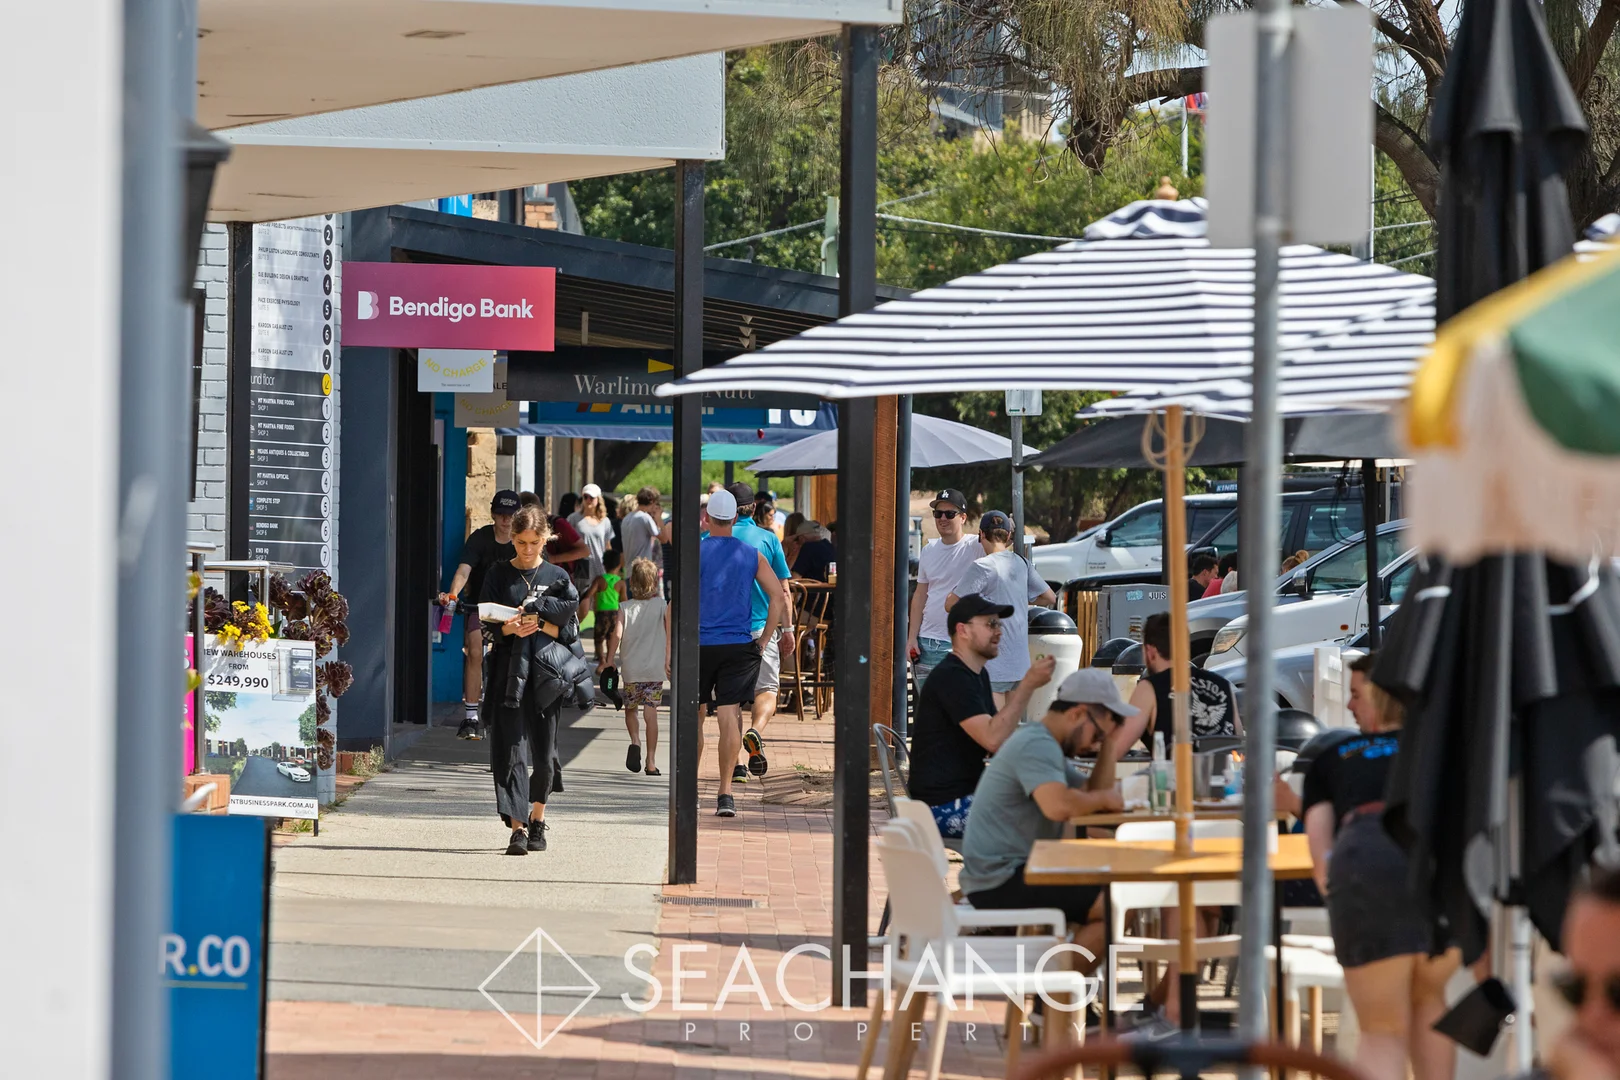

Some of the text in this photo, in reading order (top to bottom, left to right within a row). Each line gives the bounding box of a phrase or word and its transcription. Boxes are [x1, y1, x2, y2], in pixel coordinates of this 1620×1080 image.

[326, 230, 330, 240] 2
[299, 250, 320, 258] CONSULTANTS
[326, 255, 330, 265] 3
[325, 280, 330, 290] 4
[325, 305, 329, 315] 5
[389, 296, 534, 322] Bendigo Bank
[325, 330, 329, 340] 6
[325, 354, 329, 365] 7
[424, 358, 488, 378] NO CHARGE
[262, 373, 275, 386] floor
[460, 399, 513, 415] NO CHARGE
[325, 428, 329, 438] 2
[325, 453, 328, 463] 3
[324, 478, 328, 488] 4
[324, 502, 327, 512] 5
[324, 527, 327, 536] 6
[323, 551, 327, 561] 7
[221, 650, 277, 660] WAREHOUSES
[208, 673, 268, 688] $249,990
[230, 799, 314, 808] NTBUSINESSPARK.COM.AU
[158, 933, 250, 978] R.CO
